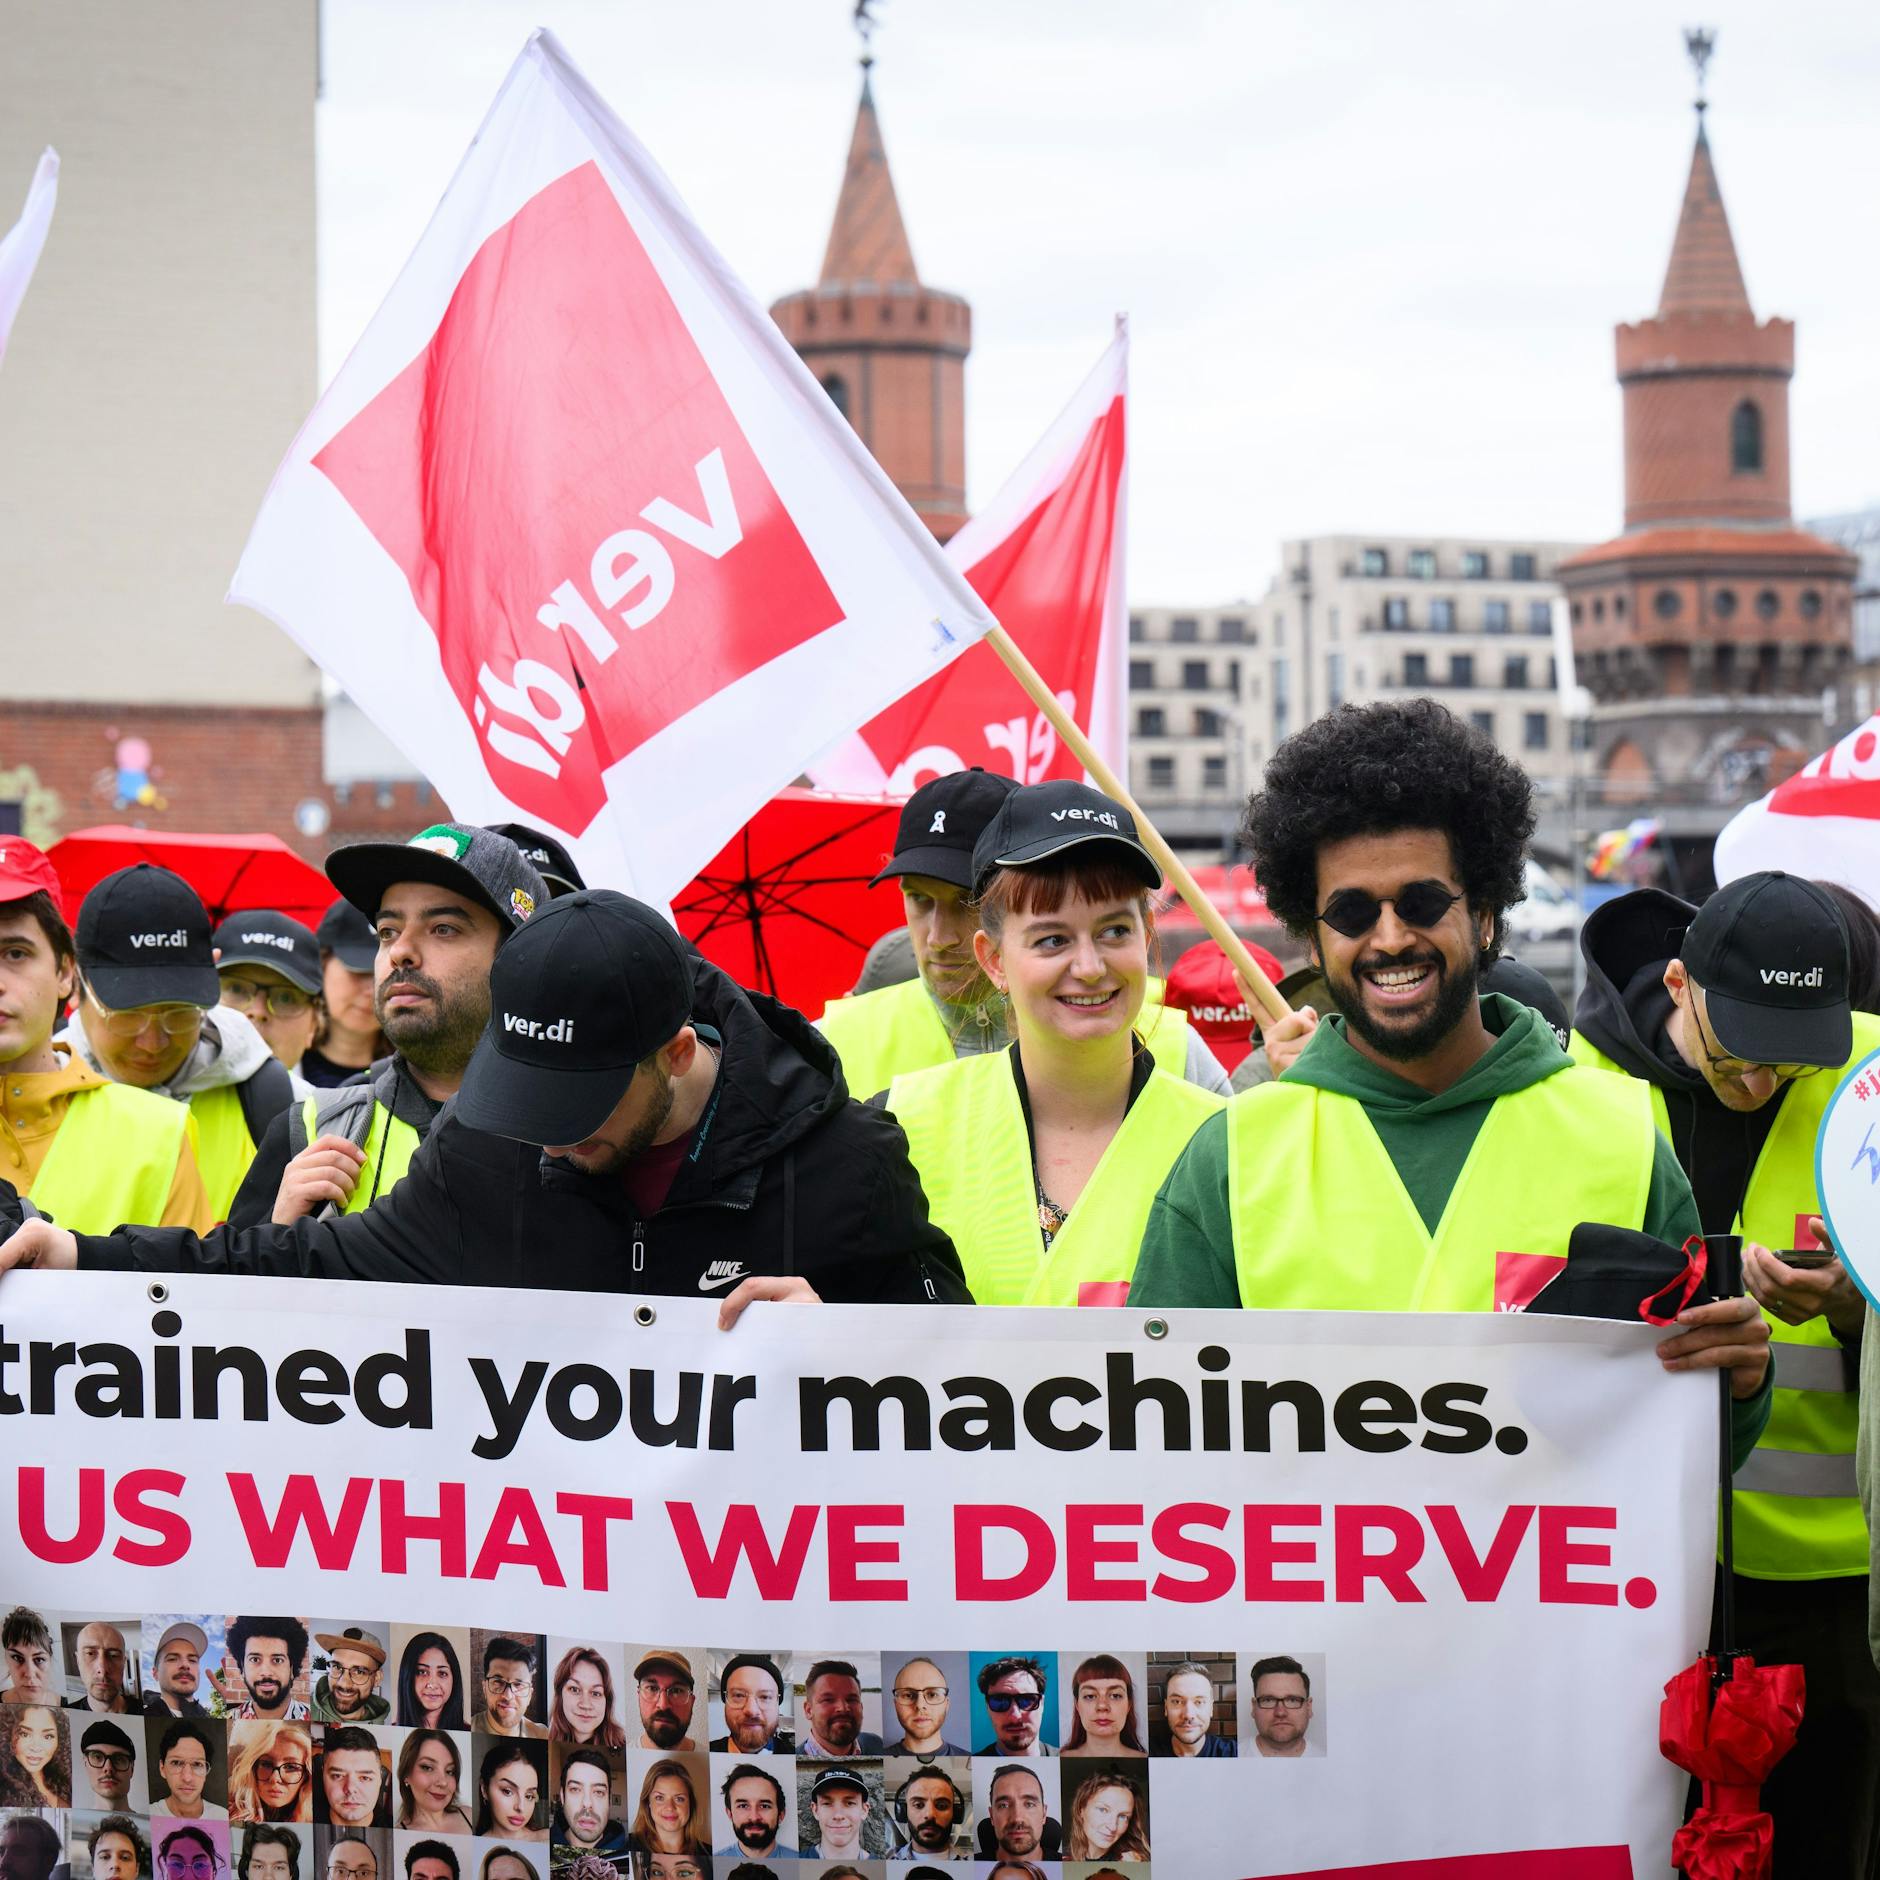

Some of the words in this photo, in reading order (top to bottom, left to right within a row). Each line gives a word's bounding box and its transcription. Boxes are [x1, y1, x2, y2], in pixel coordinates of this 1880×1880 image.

[1050, 808, 1119, 831] ver.di
[518, 847, 550, 865] r.di
[130, 930, 188, 949] ver.di
[241, 932, 295, 952] ver.di
[1760, 967, 1823, 987] ver.di
[503, 1012, 574, 1043] ver.di
[707, 1260, 744, 1277] NIKE
[467, 1357, 757, 1461] your
[798, 1345, 1529, 1456] machines.
[17, 1466, 192, 1568] US
[225, 1471, 634, 1592] WHAT
[664, 1500, 909, 1602] WE
[953, 1501, 1658, 1610] DESERVE.
